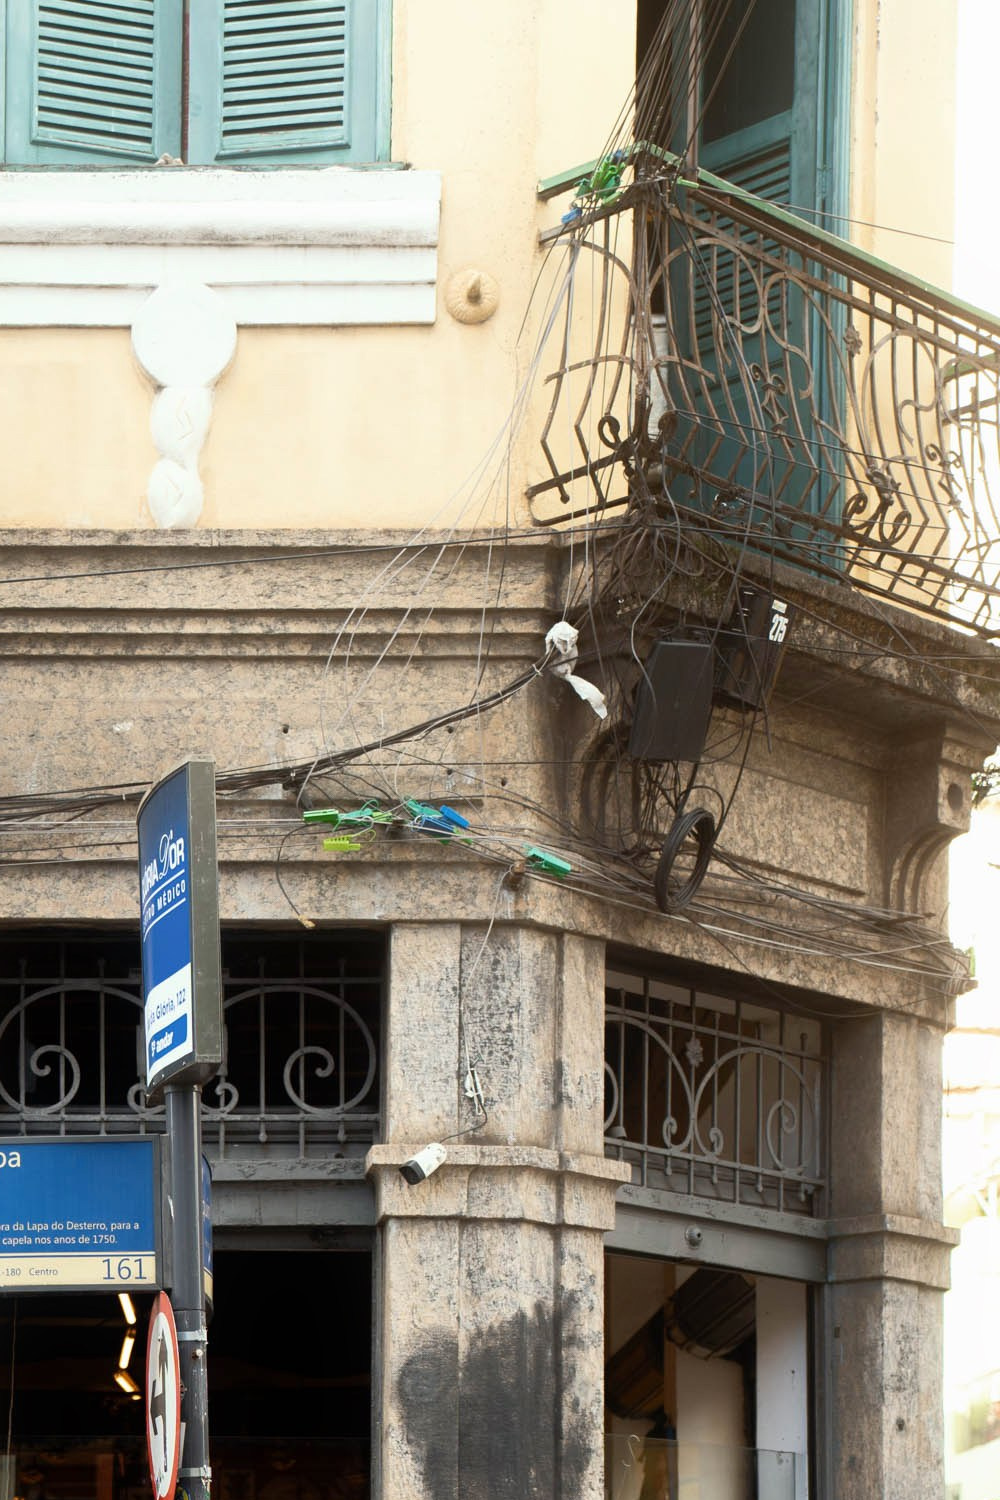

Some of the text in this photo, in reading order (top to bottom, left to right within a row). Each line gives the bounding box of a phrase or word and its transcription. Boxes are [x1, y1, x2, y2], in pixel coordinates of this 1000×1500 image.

[157, 879, 186, 911] MÉDICO
[12, 1221, 25, 1231] da
[26, 1221, 49, 1233] Lapa
[51, 1220, 64, 1231] do
[66, 1221, 108, 1231] Desterro,
[110, 1222, 131, 1232] para
[133, 1222, 140, 1230] a
[2, 1235, 32, 1247] capela
[34, 1236, 52, 1245] nos
[54, 1235, 76, 1245] anos
[78, 1234, 90, 1244] de
[92, 1234, 118, 1244] 1750.
[28, 1267, 59, 1277] Centro
[102, 1257, 147, 1280] 161
